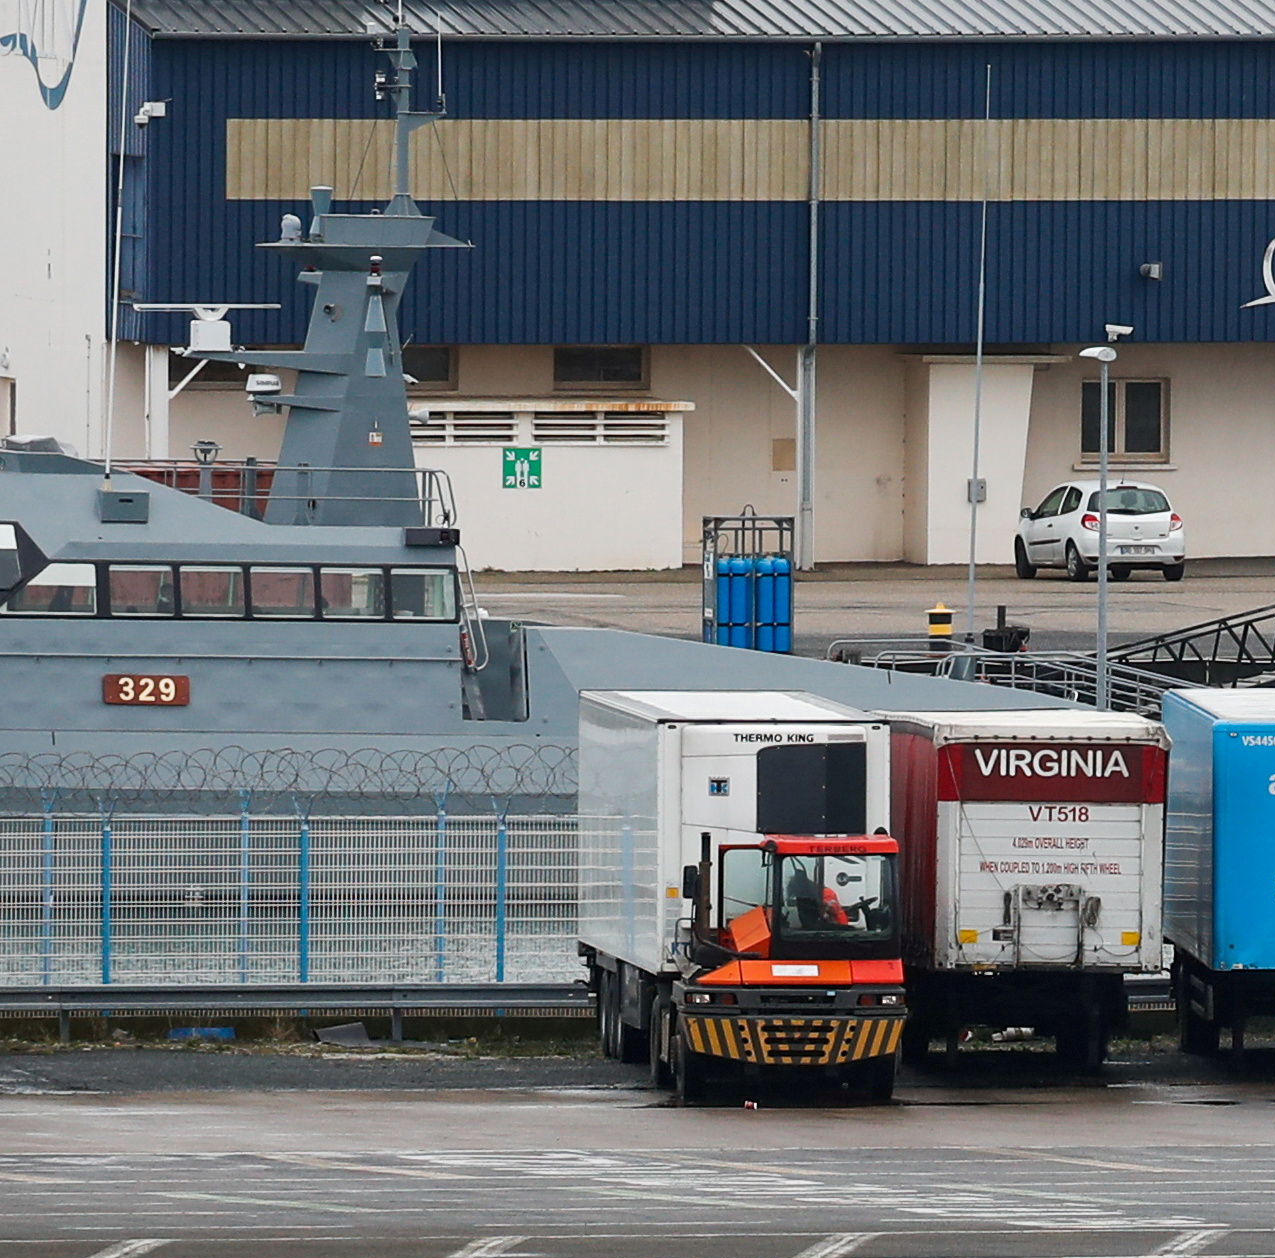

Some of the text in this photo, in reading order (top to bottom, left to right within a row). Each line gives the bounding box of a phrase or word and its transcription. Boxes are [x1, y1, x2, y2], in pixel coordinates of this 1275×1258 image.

[519, 479, 526, 488] 6
[118, 677, 176, 702] 329
[733, 733, 814, 743] THERMO KING
[974, 748, 1130, 778] VIRGINIA
[1028, 805, 1090, 822] VT518
[809, 845, 867, 853] TERBERG
[1035, 837, 1089, 849] OVERALL HEIGHT
[980, 861, 998, 873] WHEN
[1000, 861, 1030, 873] COUPLED
[1031, 861, 1040, 873] TO
[1099, 862, 1122, 875] WHEEL
